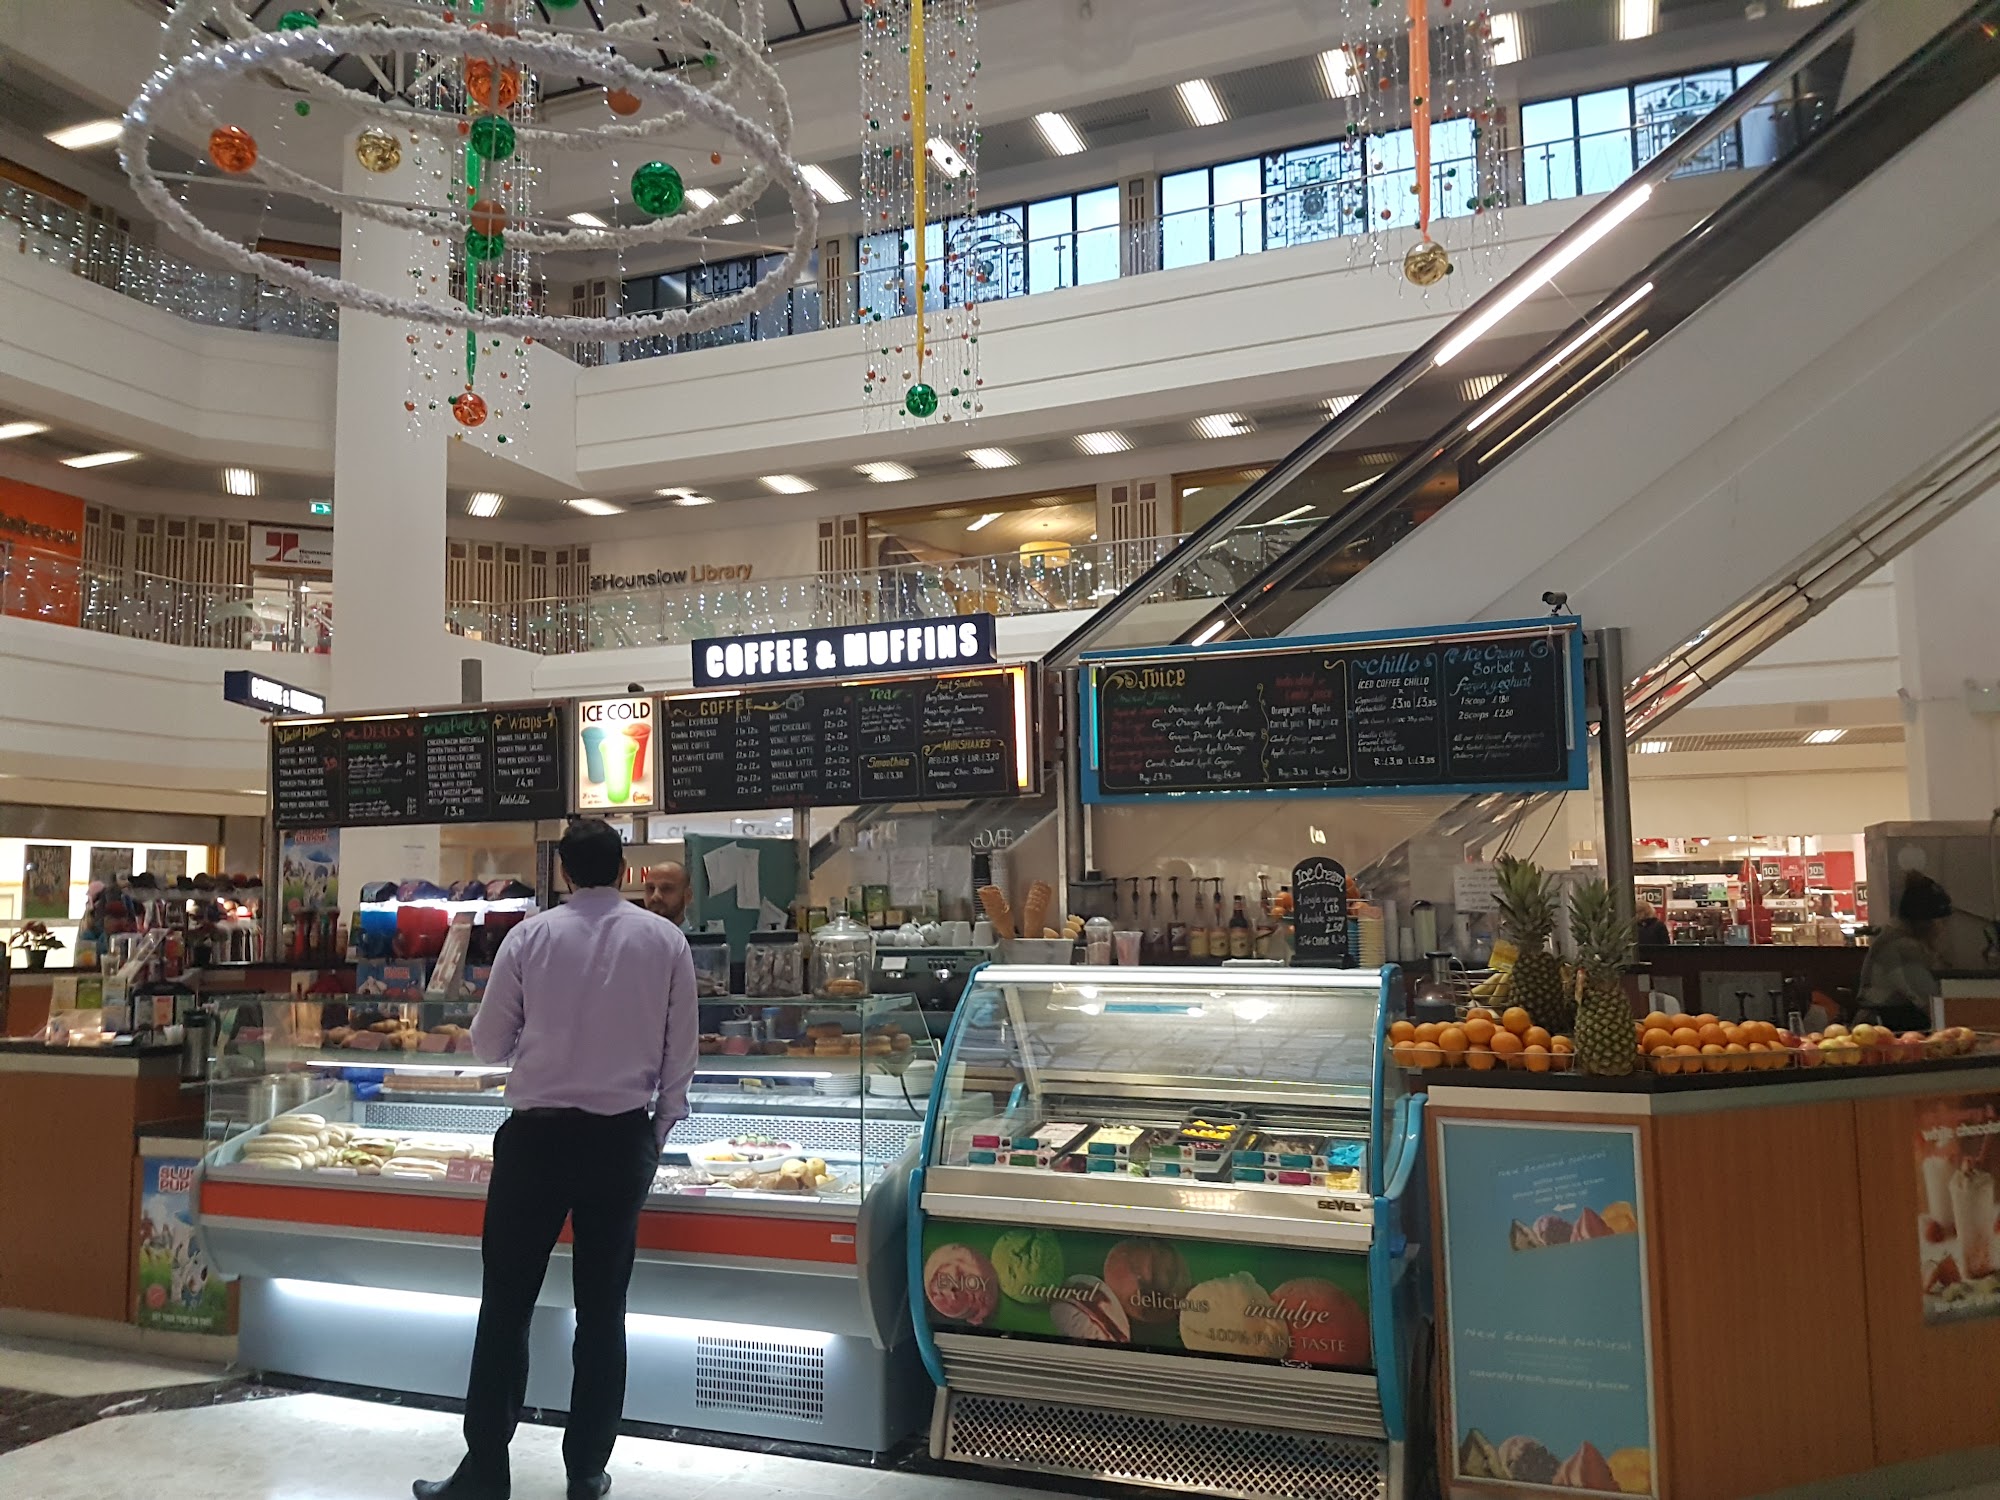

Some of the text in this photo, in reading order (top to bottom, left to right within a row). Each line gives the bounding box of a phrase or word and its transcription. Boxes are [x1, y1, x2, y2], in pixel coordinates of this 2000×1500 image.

[602, 564, 753, 591] Hounslow Library
[706, 622, 978, 678] COFFEE & MUFFINS
[1473, 660, 1514, 676] Sorbet
[1376, 678, 1400, 688] COFFEE
[582, 702, 650, 722] ICE COLD
[700, 698, 753, 718] COFFEE
[508, 713, 541, 732] Wraps
[943, 739, 991, 751] MILKSHAKES
[867, 755, 910, 769] Smoothies
[1317, 1199, 1361, 1213] SEVEL
[936, 1272, 991, 1293] ENJOY
[1020, 1281, 1100, 1302] natural
[1129, 1290, 1210, 1314] delicious
[1244, 1298, 1330, 1329] indulge
[1300, 1336, 1347, 1353] TASTE
